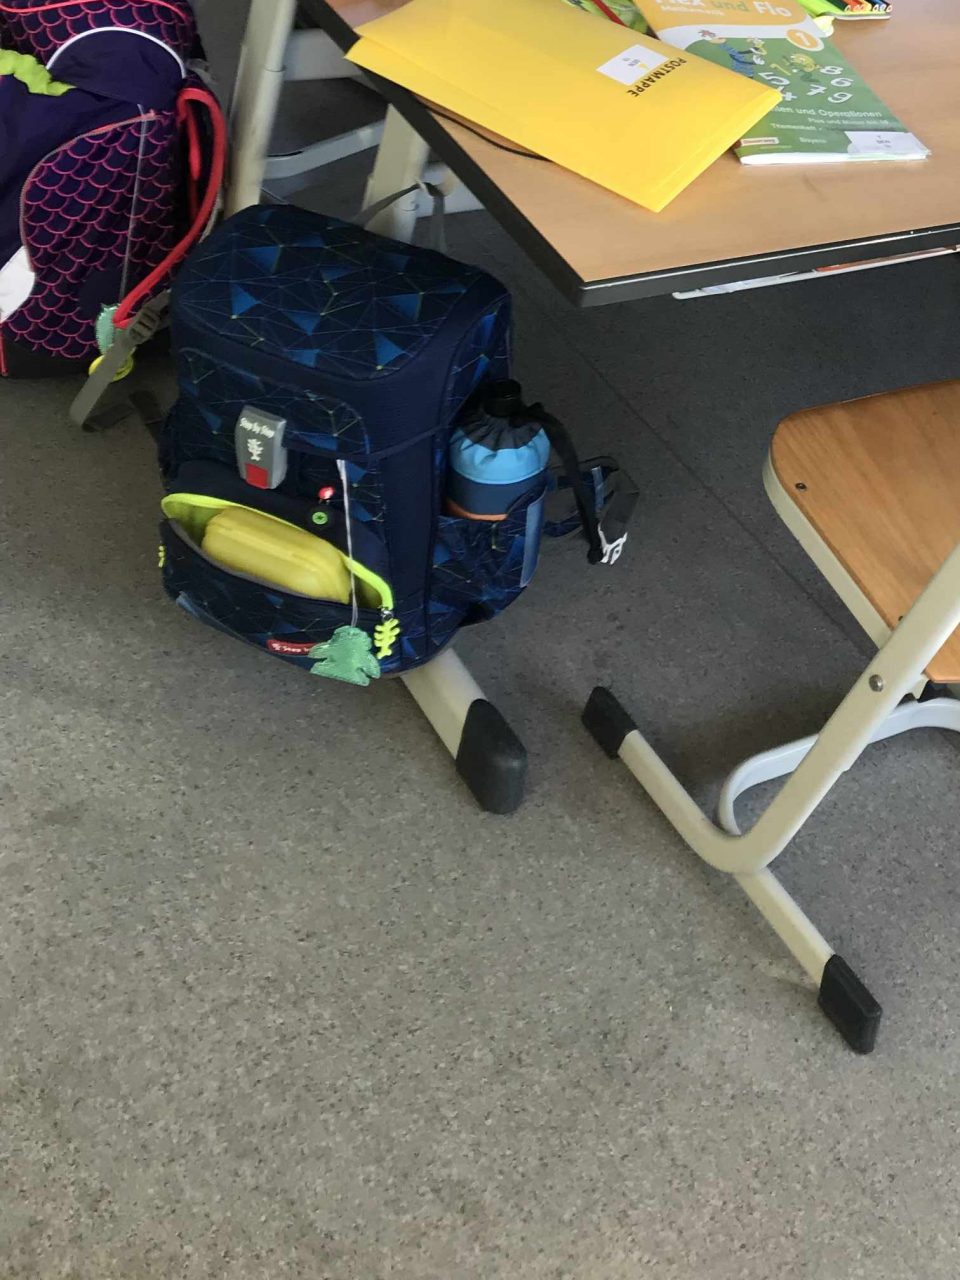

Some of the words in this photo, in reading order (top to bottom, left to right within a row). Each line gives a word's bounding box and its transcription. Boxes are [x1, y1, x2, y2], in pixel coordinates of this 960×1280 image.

[711, 0, 751, 12] und
[753, 0, 792, 18] Flo
[796, 31, 811, 47] 1
[819, 65, 844, 75] 8
[626, 57, 688, 98] POSTMAPPE
[758, 72, 790, 86] 5
[830, 77, 854, 87] 6
[806, 84, 827, 96] 7
[827, 91, 853, 103] 9
[795, 108, 816, 116] und
[818, 108, 883, 118] Operationen
